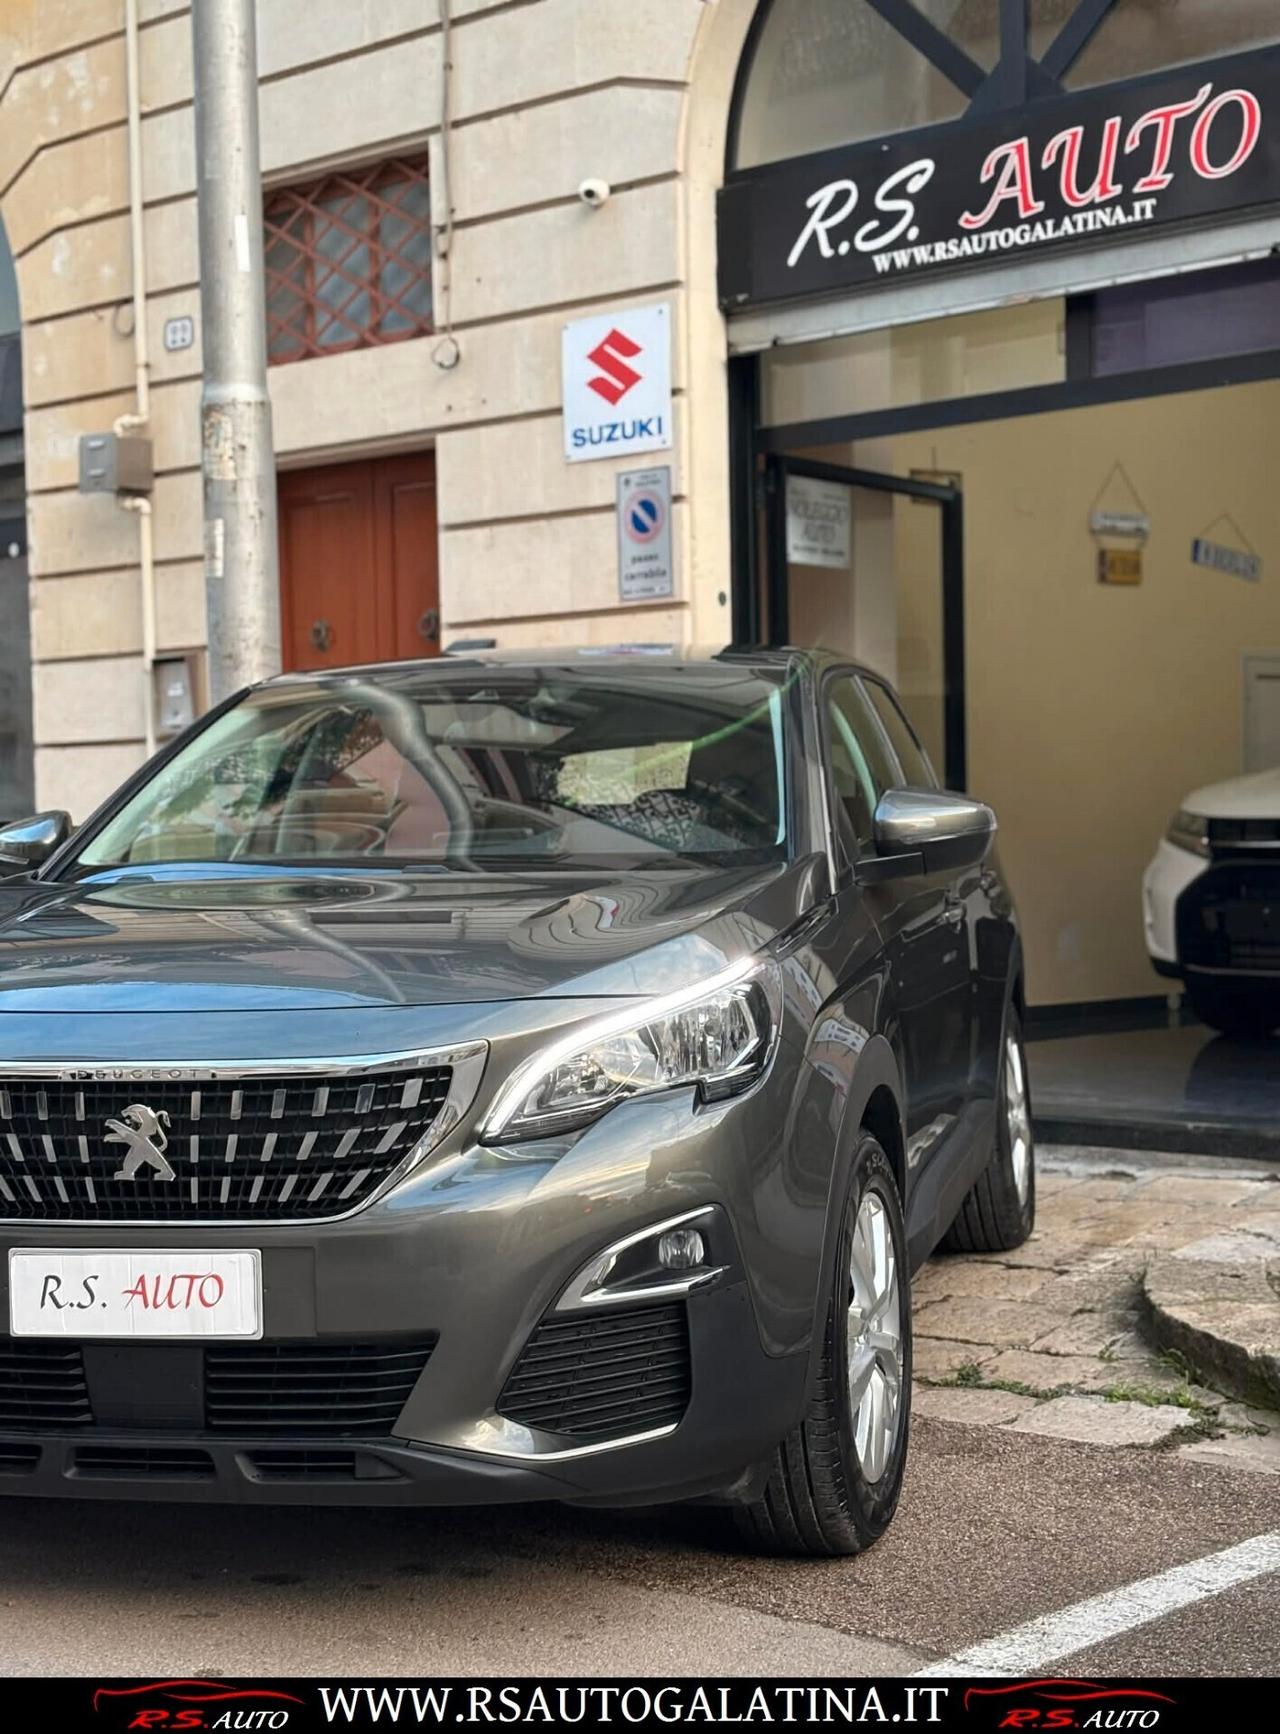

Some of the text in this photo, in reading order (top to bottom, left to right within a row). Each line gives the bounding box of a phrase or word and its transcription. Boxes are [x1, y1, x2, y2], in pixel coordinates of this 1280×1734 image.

[787, 82, 1262, 267] R.S. AUTO
[873, 198, 1156, 273] WWW.RSAUTOGALATINA.IT
[572, 417, 663, 447] SUZUKI
[76, 1069, 201, 1079] PEUGEOT
[40, 1273, 225, 1311] R.S. AUTO
